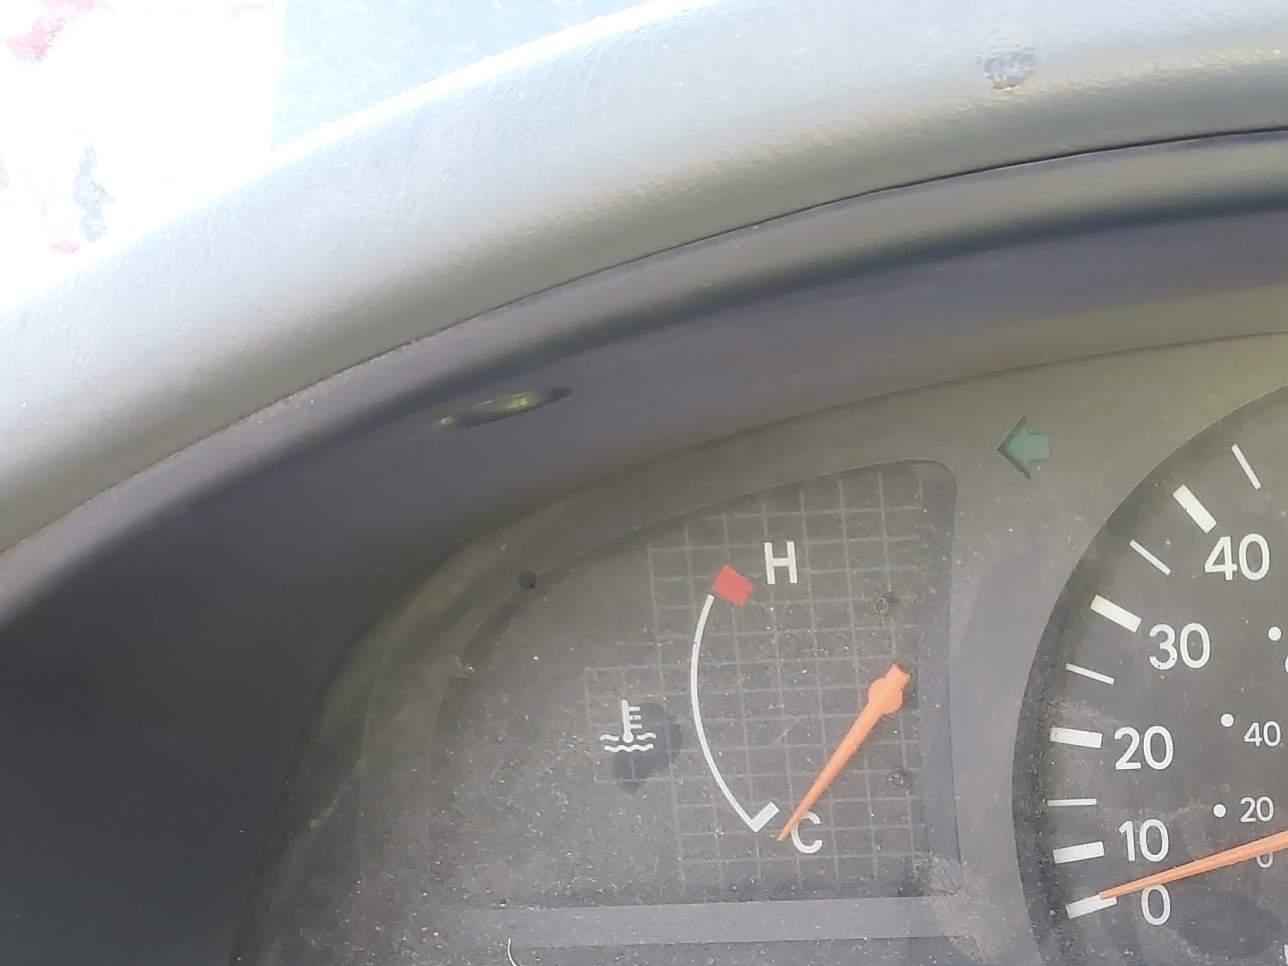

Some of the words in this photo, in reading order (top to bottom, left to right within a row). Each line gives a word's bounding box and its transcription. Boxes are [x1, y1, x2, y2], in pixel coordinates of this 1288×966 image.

[764, 541, 798, 584] H
[1205, 534, 1270, 580] 40
[1149, 623, 1210, 670] 30
[1114, 726, 1173, 770] 20
[1244, 721, 1281, 747] 40
[1240, 796, 1273, 822] 20
[791, 812, 822, 854] C
[1118, 819, 1169, 862] 10
[1141, 884, 1171, 926] 0
